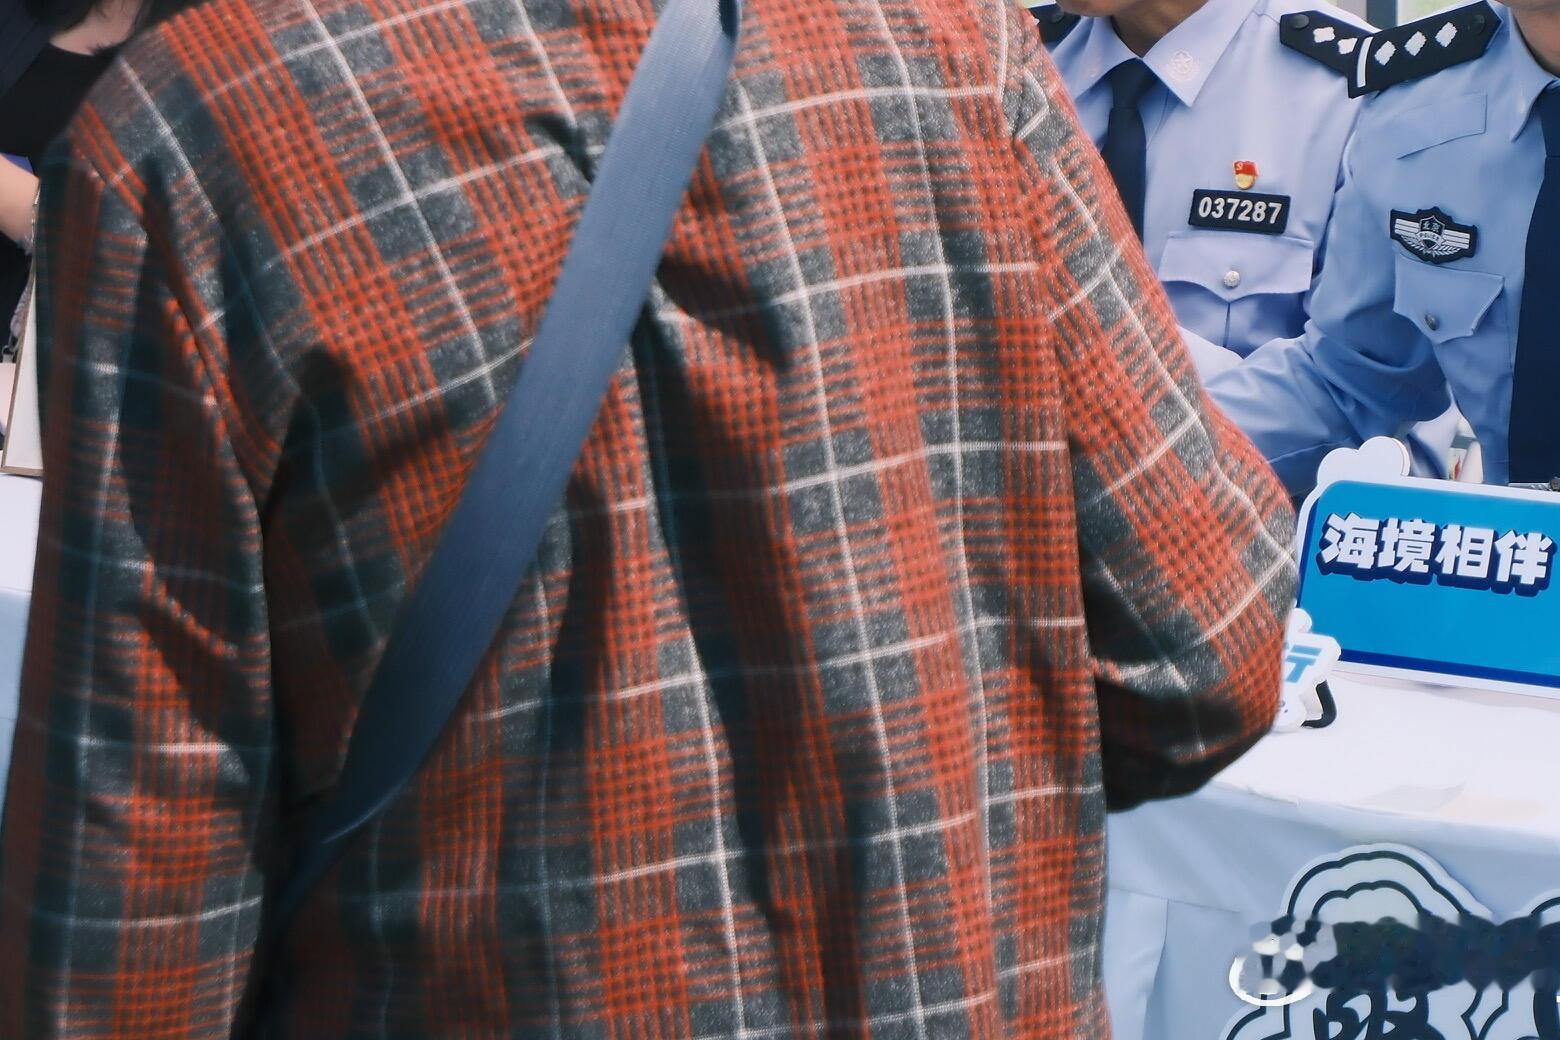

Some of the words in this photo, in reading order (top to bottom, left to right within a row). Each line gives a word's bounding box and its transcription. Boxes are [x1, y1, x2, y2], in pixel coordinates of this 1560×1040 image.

[1198, 196, 1283, 224] 037287
[1318, 511, 1556, 595] 海境相伴
